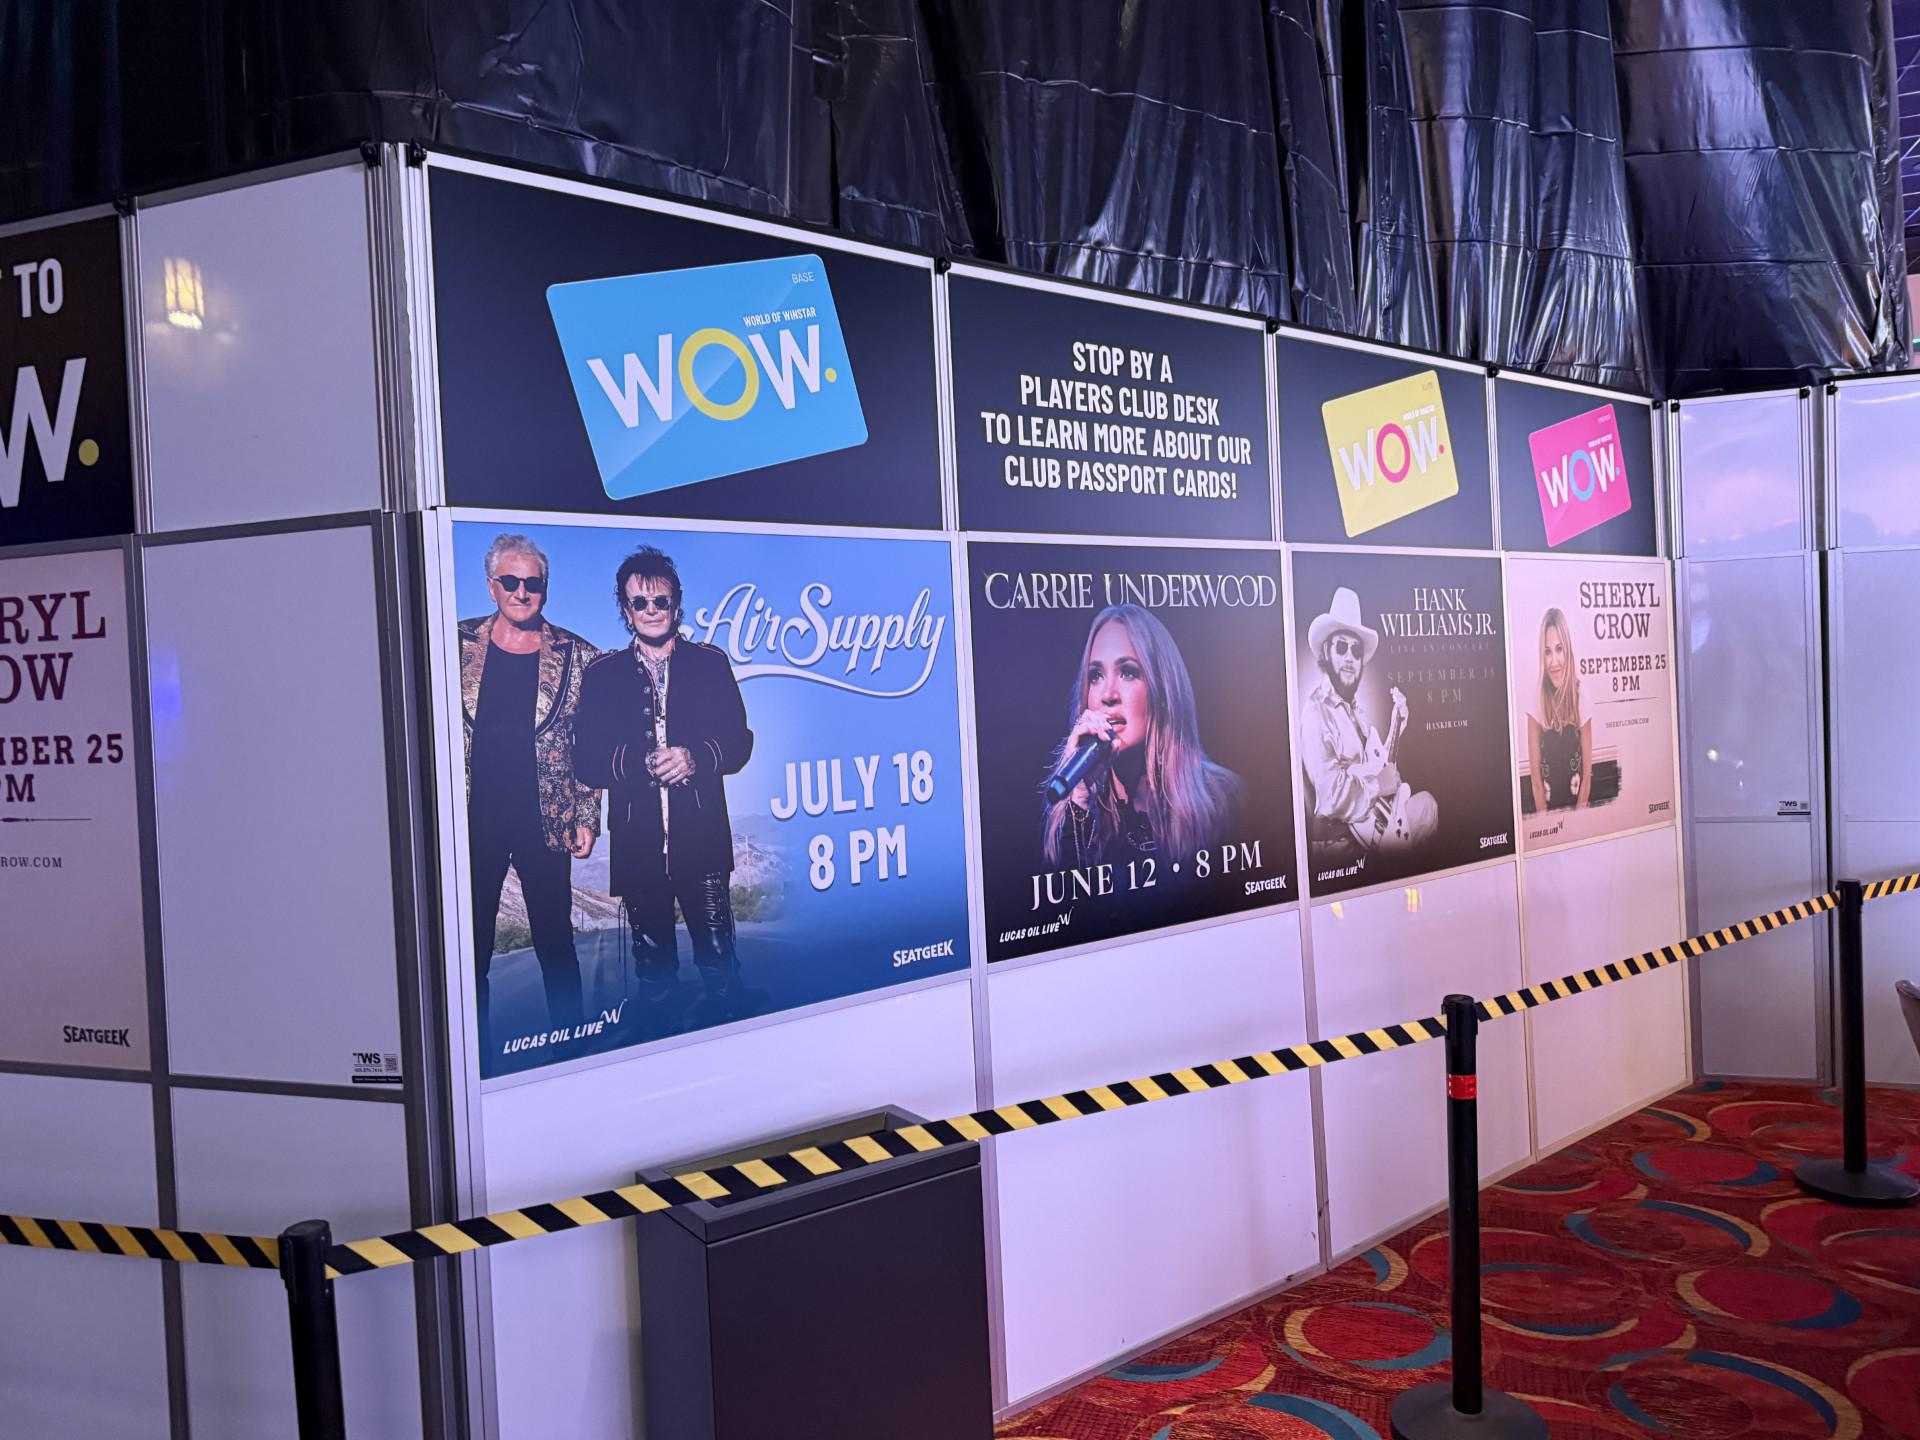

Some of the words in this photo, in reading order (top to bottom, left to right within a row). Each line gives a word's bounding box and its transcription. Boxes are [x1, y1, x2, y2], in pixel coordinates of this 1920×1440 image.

[13, 257, 64, 318] TO
[791, 271, 815, 285] BASE
[743, 313, 771, 328] WORLD
[771, 311, 782, 323] OF
[782, 306, 817, 321] WINSTAR
[1072, 341, 1125, 376] STOP
[1130, 350, 1154, 381] BY
[1160, 354, 1173, 383] A
[1020, 374, 1114, 415] PLAYERS
[1118, 387, 1169, 420] CLUB
[1173, 393, 1220, 426] DESK
[980, 411, 1011, 445] TO
[1017, 415, 1087, 451] LEARN
[1094, 423, 1148, 457] MORE
[1152, 429, 1212, 462] ABOUT
[1217, 436, 1252, 465] OUR
[1004, 456, 1061, 488] CLUB
[1067, 460, 1167, 496] PASSPORT
[1173, 468, 1237, 499] CARDS!
[985, 572, 1093, 609] CARRIE
[1104, 574, 1277, 608] UNDERWOOD
[1413, 588, 1467, 611] HANK
[1580, 581, 1660, 608] SHERYL
[695, 583, 777, 662] Air
[780, 583, 946, 692] Supply
[1380, 612, 1472, 637] WILLIAMS
[1475, 613, 1496, 636] JR.
[1594, 613, 1650, 640] CROW
[1387, 668, 1475, 683] SEPTEMBER
[1580, 656, 1652, 675] SEPTEMBER
[1655, 654, 1666, 670] 25
[1442, 688, 1462, 703] PM
[1612, 677, 1618, 692] 8
[1622, 675, 1640, 691] PM
[87, 733, 124, 764] 25
[770, 755, 880, 820] JULY
[893, 751, 933, 804] 18
[1480, 832, 1508, 848] SEATGEEK
[809, 834, 835, 891] 8
[849, 824, 908, 884] PM
[1031, 864, 1114, 910] JUNE
[1128, 858, 1157, 890] 12
[1196, 849, 1210, 878] 8
[1222, 840, 1263, 873] PM
[1245, 875, 1287, 895] SEATGEEK
[1317, 870, 1335, 881] LUCAS
[1336, 868, 1344, 877] OIL
[1346, 866, 1357, 875] LIVE
[1000, 928, 1026, 943] LUCAS
[1028, 926, 1040, 937] OIL
[1042, 922, 1060, 935] LIVE
[893, 939, 954, 967] SEATGEEK
[63, 1024, 130, 1047] SEATGEEK
[503, 1033, 547, 1054] LUCAS
[550, 1028, 570, 1044] OIL
[574, 1021, 604, 1039] LIVE
